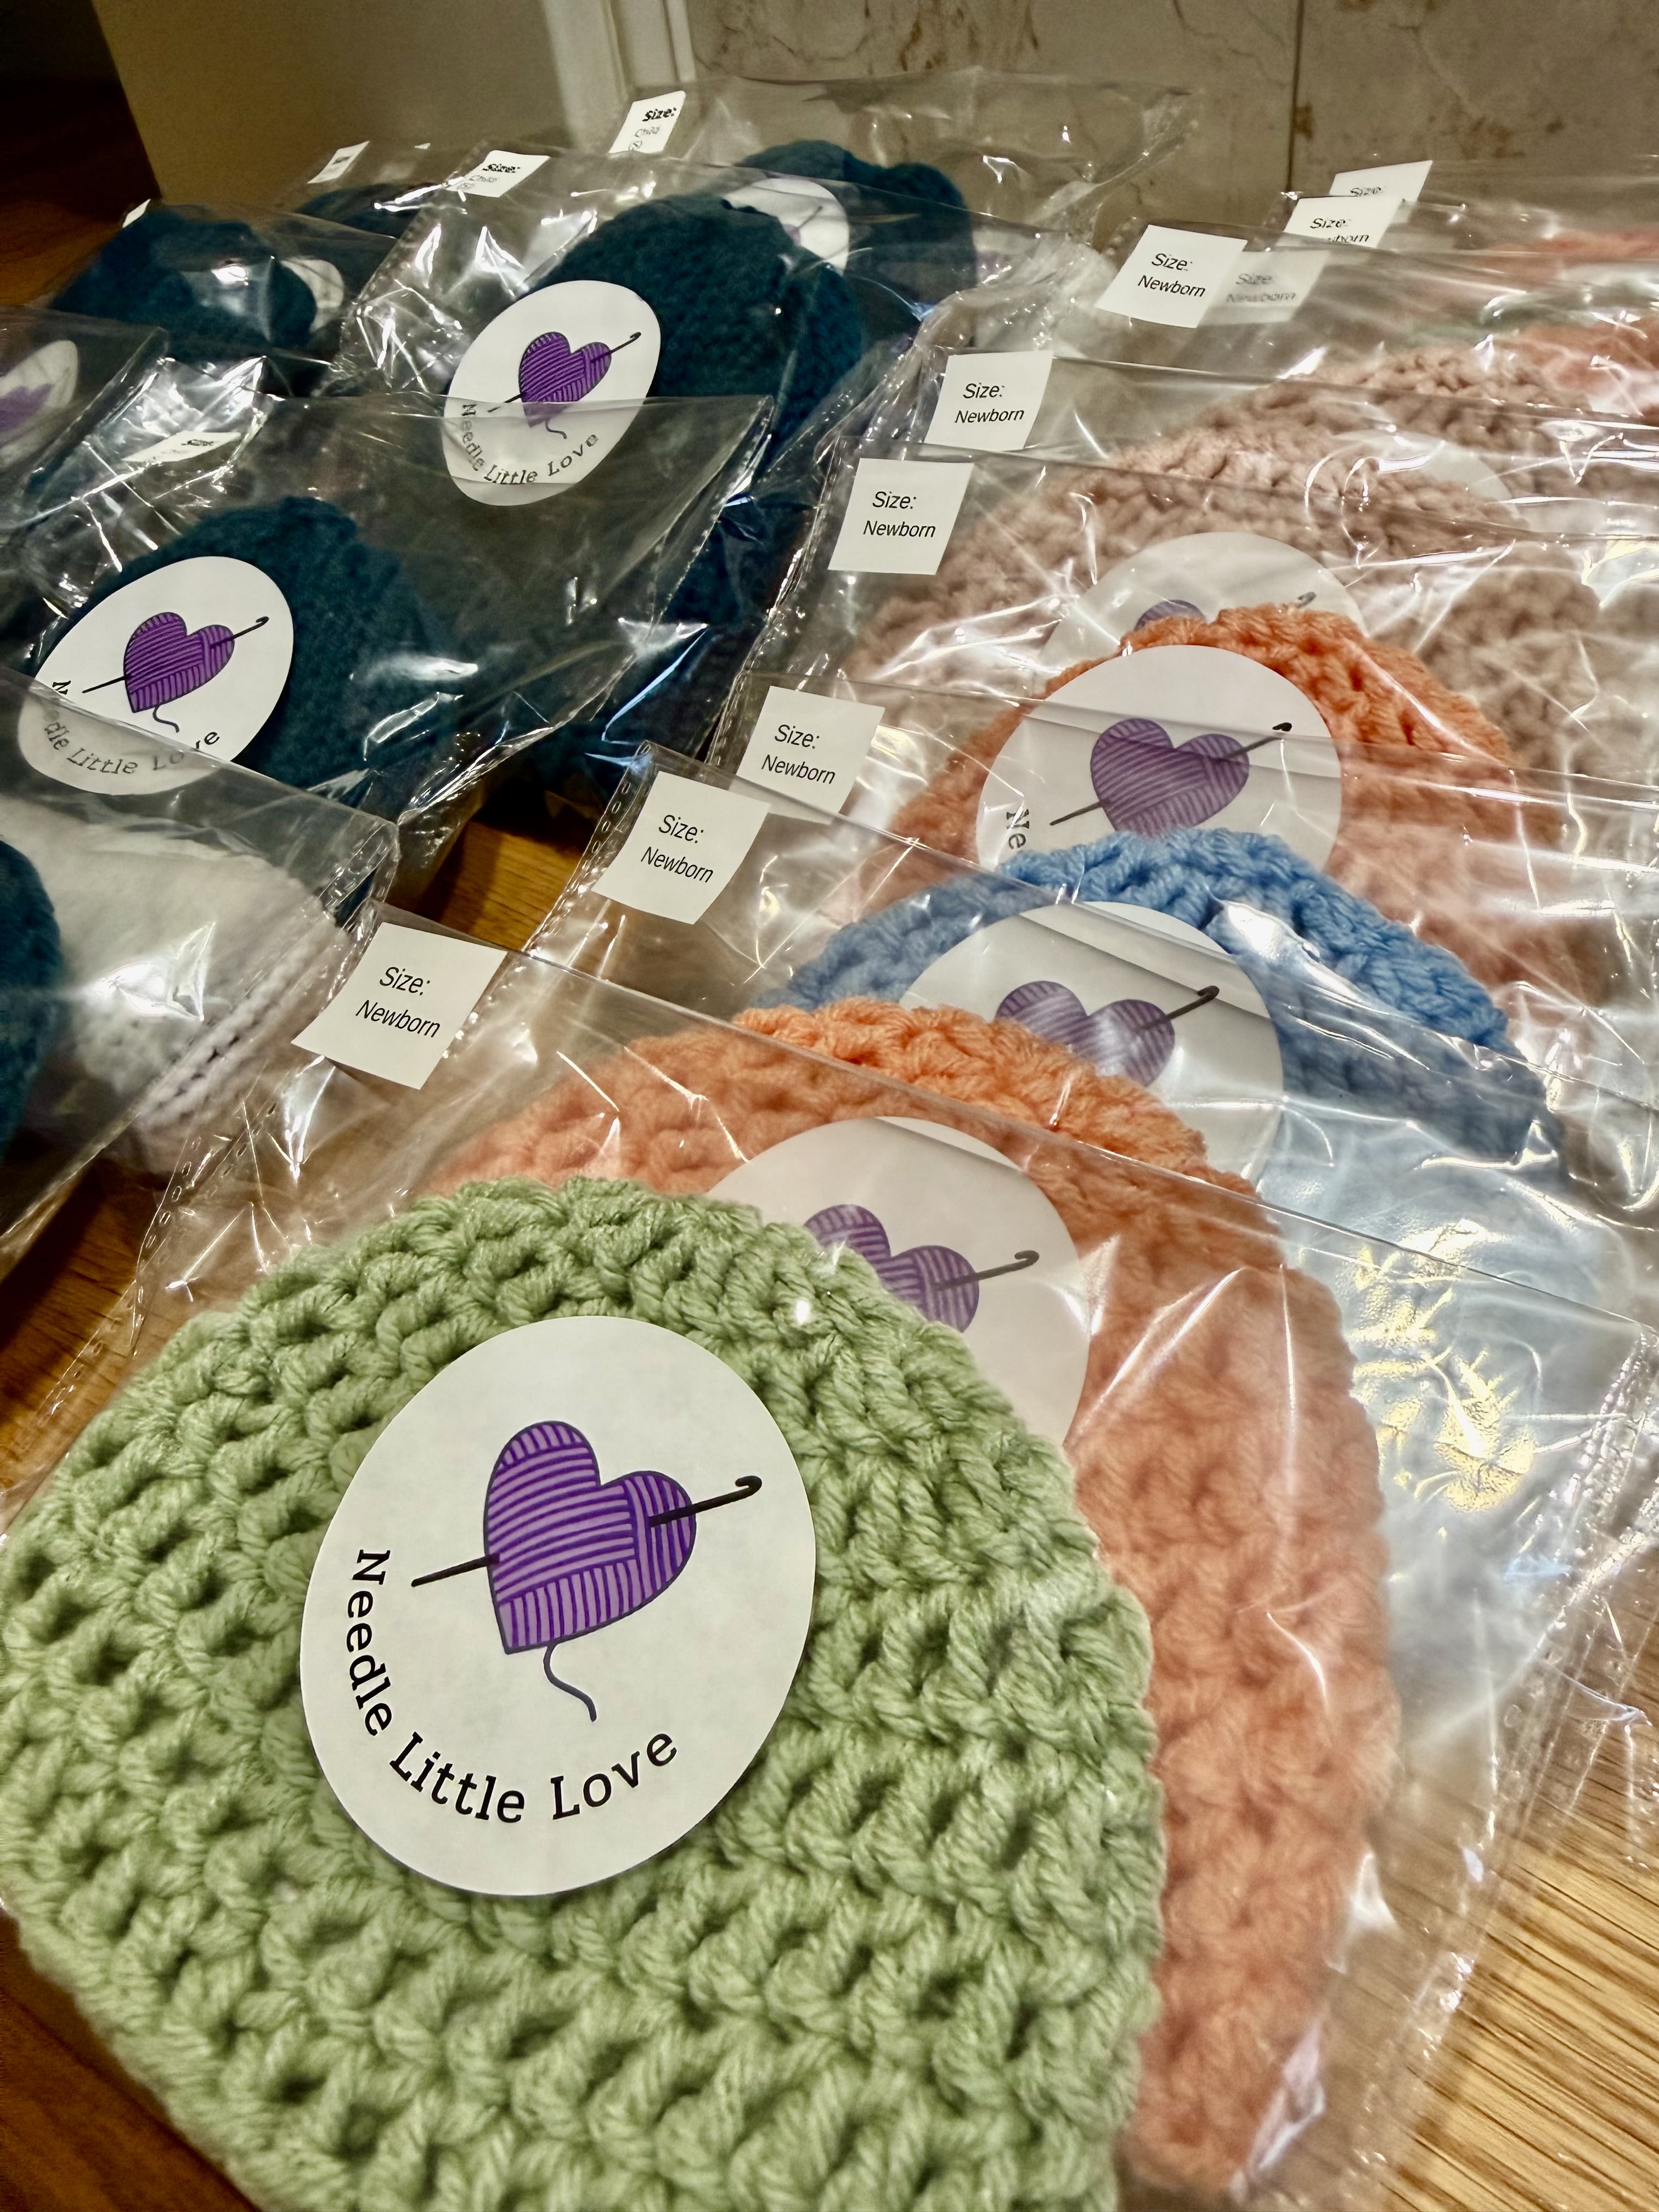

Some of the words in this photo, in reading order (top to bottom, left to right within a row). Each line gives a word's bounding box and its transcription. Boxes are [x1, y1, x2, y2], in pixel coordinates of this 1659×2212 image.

[1151, 253, 1193, 272] Size:
[1137, 274, 1206, 297] Newborn
[962, 382, 1006, 399] Size:
[955, 408, 1025, 424] Newborn
[483, 464, 538, 485] Little
[548, 434, 599, 476] Love
[872, 490, 917, 510] Size:
[862, 520, 936, 538] Newborn
[774, 724, 821, 750] Size:
[66, 747, 138, 774] Little
[761, 754, 837, 785] Newborn
[658, 814, 705, 844] Size:
[640, 846, 714, 883] Newborn
[379, 966, 431, 997] Size:
[355, 999, 441, 1039] Newborn
[346, 1549, 393, 1737] Needle
[389, 1731, 525, 1824] Little
[550, 1733, 678, 1821] Love
